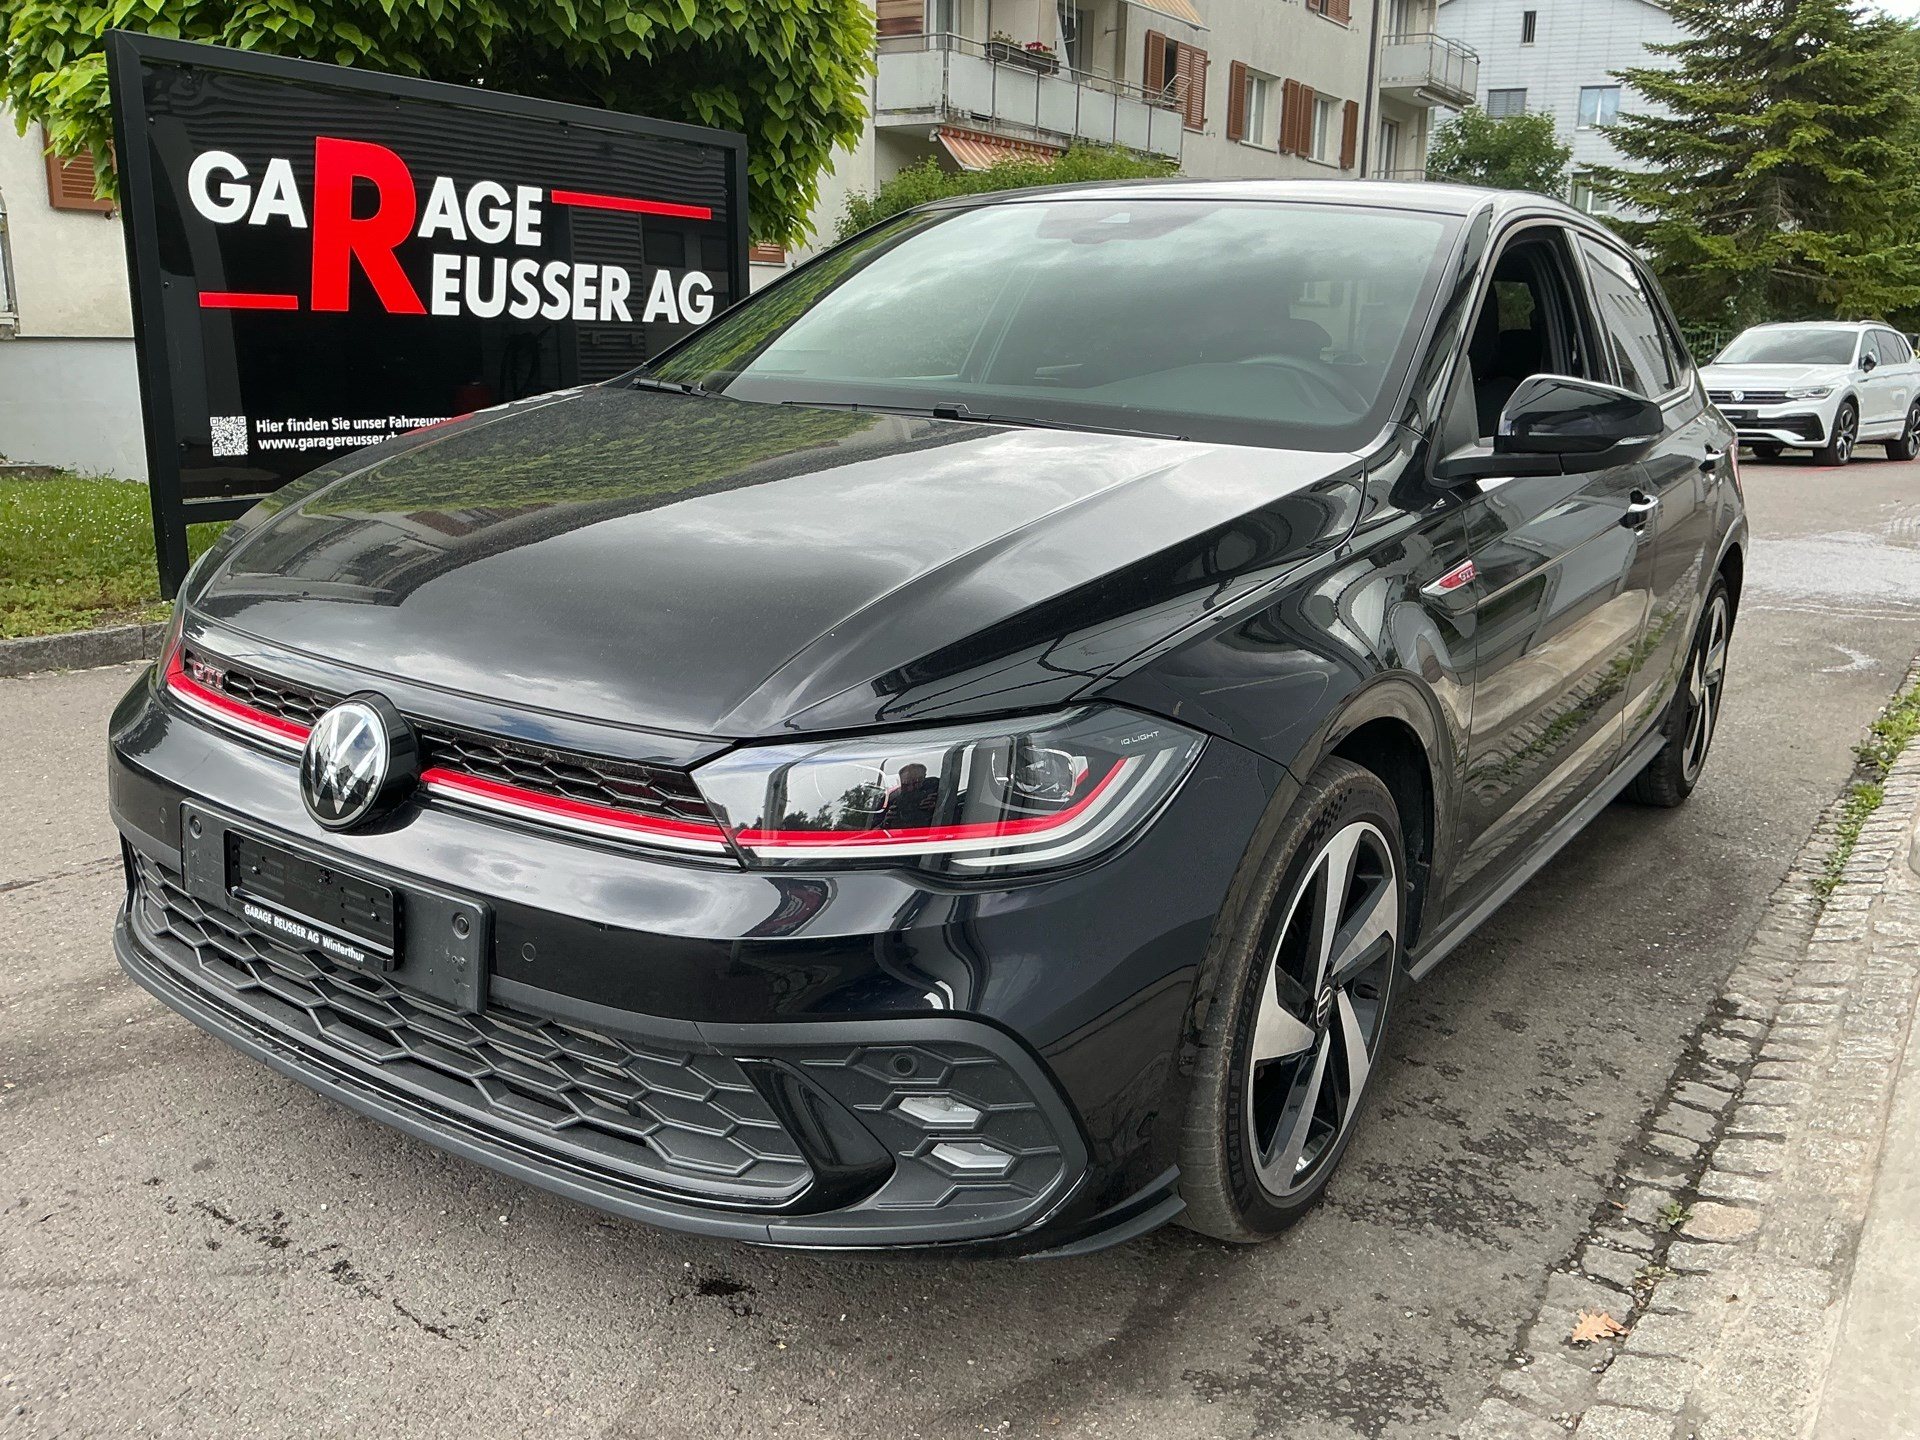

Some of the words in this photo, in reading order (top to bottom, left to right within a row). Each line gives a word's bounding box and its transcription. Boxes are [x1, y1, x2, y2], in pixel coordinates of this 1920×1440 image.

[188, 136, 543, 315] GARAGE
[642, 269, 714, 325] AG
[256, 419, 284, 433] Hier
[287, 418, 329, 432] finden
[332, 417, 351, 430] Sie
[353, 419, 387, 430] unser
[258, 431, 398, 451] www.garagereusser
[192, 661, 223, 689] GTI
[244, 904, 272, 924] GARAGE
[274, 916, 306, 939] REUSSER
[307, 929, 320, 944] AG
[322, 936, 365, 962] Winterthur
